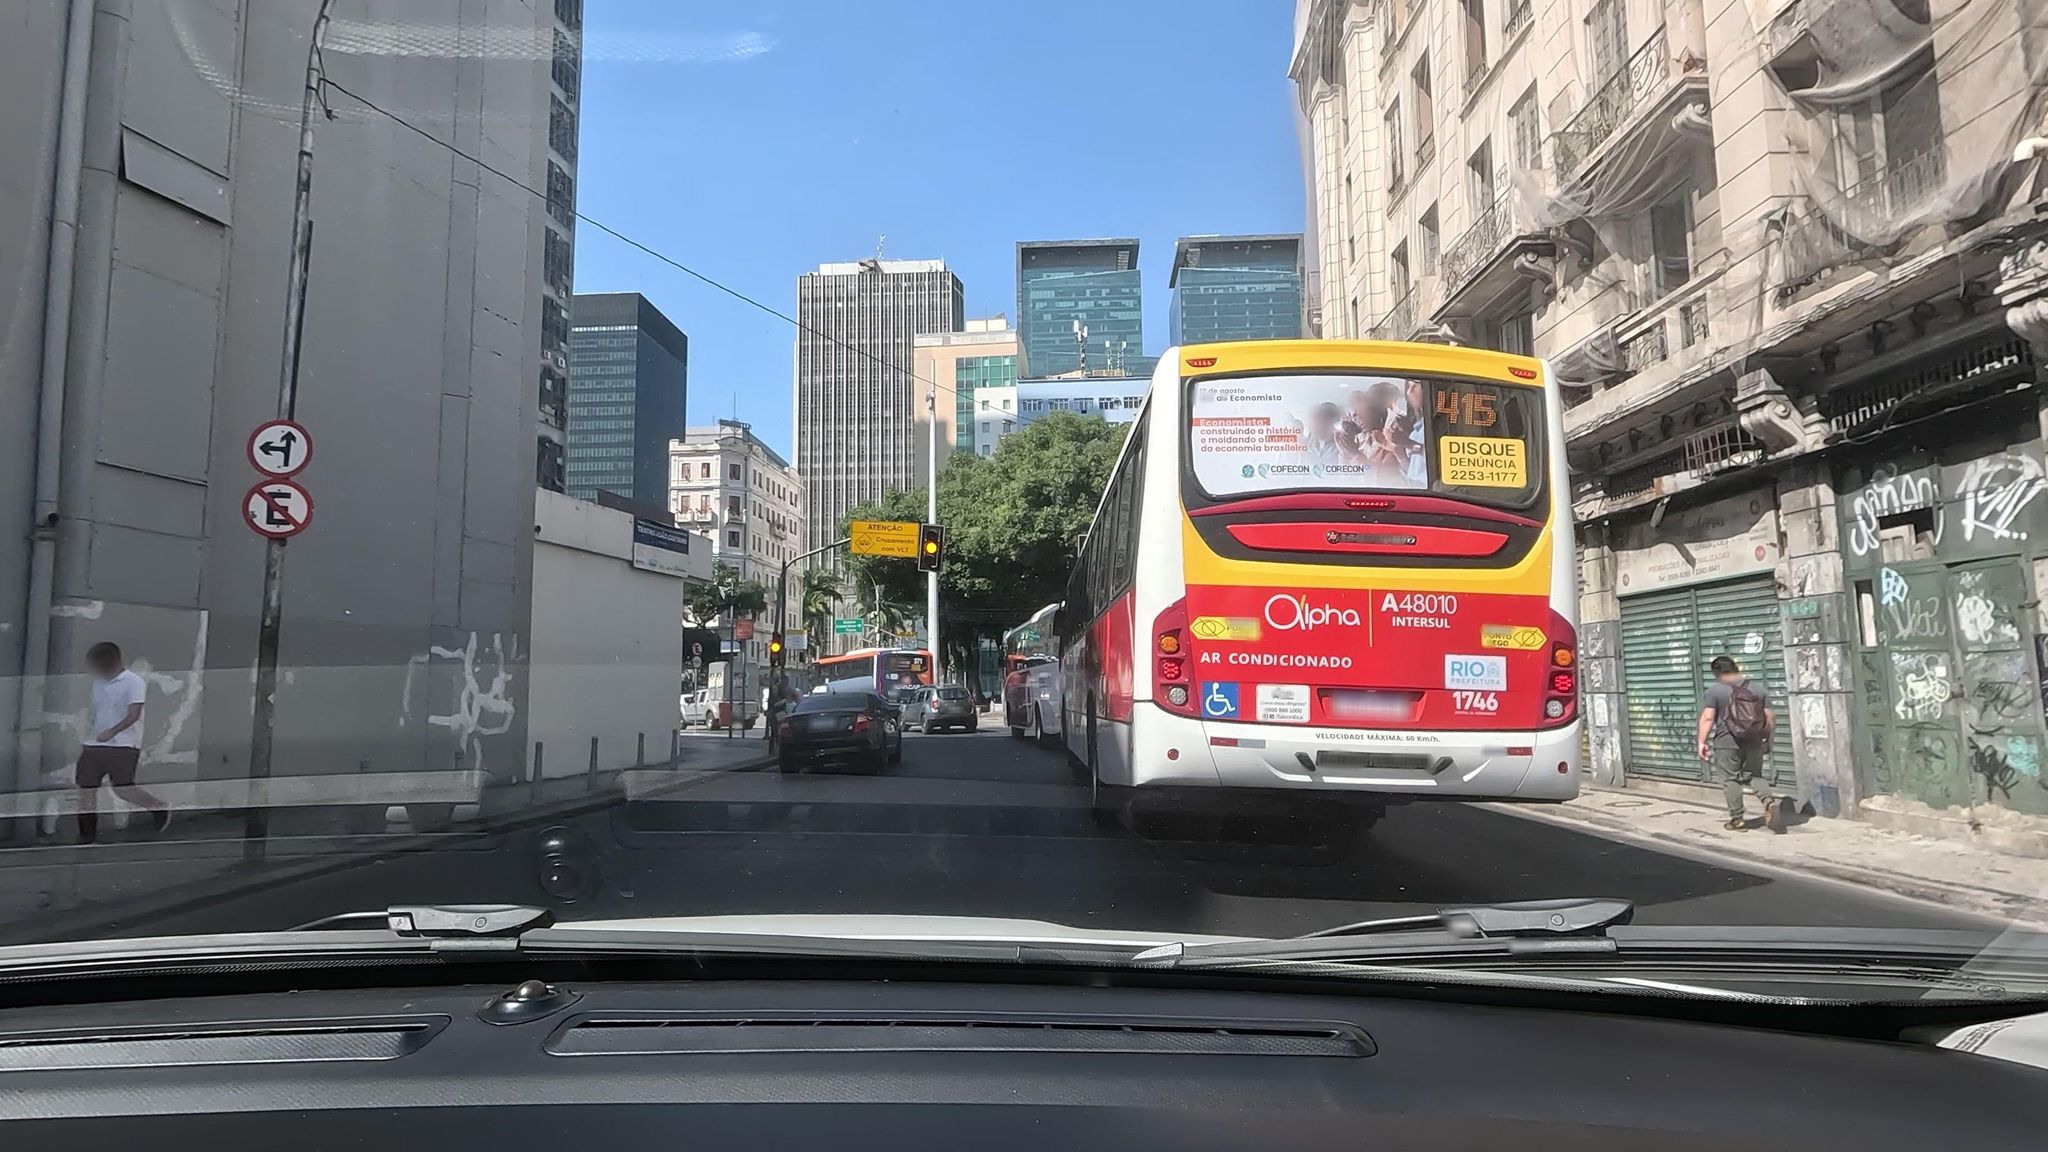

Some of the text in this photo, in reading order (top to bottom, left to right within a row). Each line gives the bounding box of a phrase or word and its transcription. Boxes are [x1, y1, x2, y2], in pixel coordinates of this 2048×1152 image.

[1229, 393, 1282, 402] Economista
[1437, 390, 1497, 427] 415
[1199, 418, 1268, 426] Economista:
[1200, 427, 1256, 435] construindo
[1266, 426, 1301, 435] história
[1208, 435, 1256, 444] moldando
[1200, 443, 1308, 453] da economia brasileira
[1449, 441, 1516, 457] DISQUE
[1449, 455, 1517, 469] DENÚNCIA
[1271, 465, 1310, 473] COFECON
[1325, 465, 1365, 473] CORECON
[1450, 470, 1517, 482] 2253-1177
[266, 492, 291, 525] E
[867, 523, 903, 532] ATENÇÃO
[876, 536, 915, 545] Cruzamento
[1380, 592, 1458, 615] A48010
[1264, 593, 1361, 631] Alpha
[1392, 616, 1451, 629] INTERSUL
[1200, 652, 1353, 669] AR CONDICIONADO
[1450, 661, 1485, 677] RIO
[1450, 677, 1501, 686] PREFEITURA
[1452, 691, 1499, 712] 1746
[1315, 733, 1366, 741] VELOCIDADE
[1367, 733, 1404, 742] MÁXIMA:
